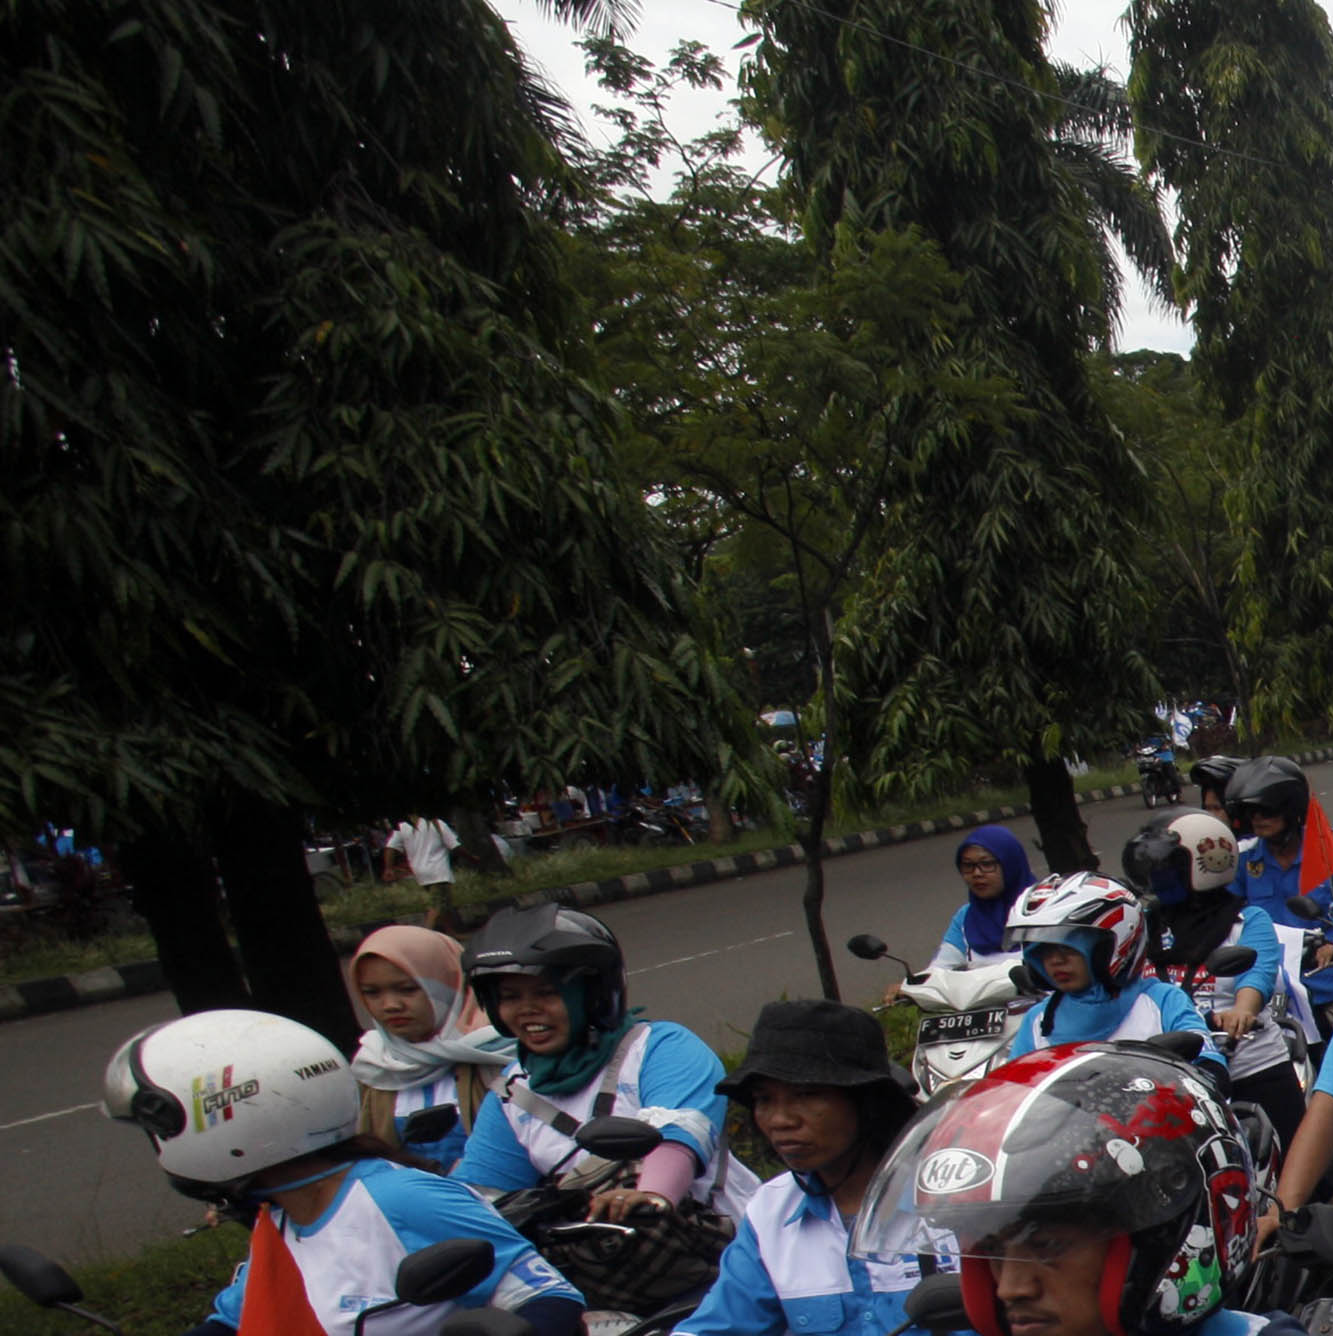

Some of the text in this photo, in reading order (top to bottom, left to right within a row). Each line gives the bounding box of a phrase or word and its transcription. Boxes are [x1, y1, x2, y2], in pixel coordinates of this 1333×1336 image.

[922, 1021, 930, 1032] F
[939, 1014, 973, 1030] 5078
[926, 1157, 972, 1189] Kyt
